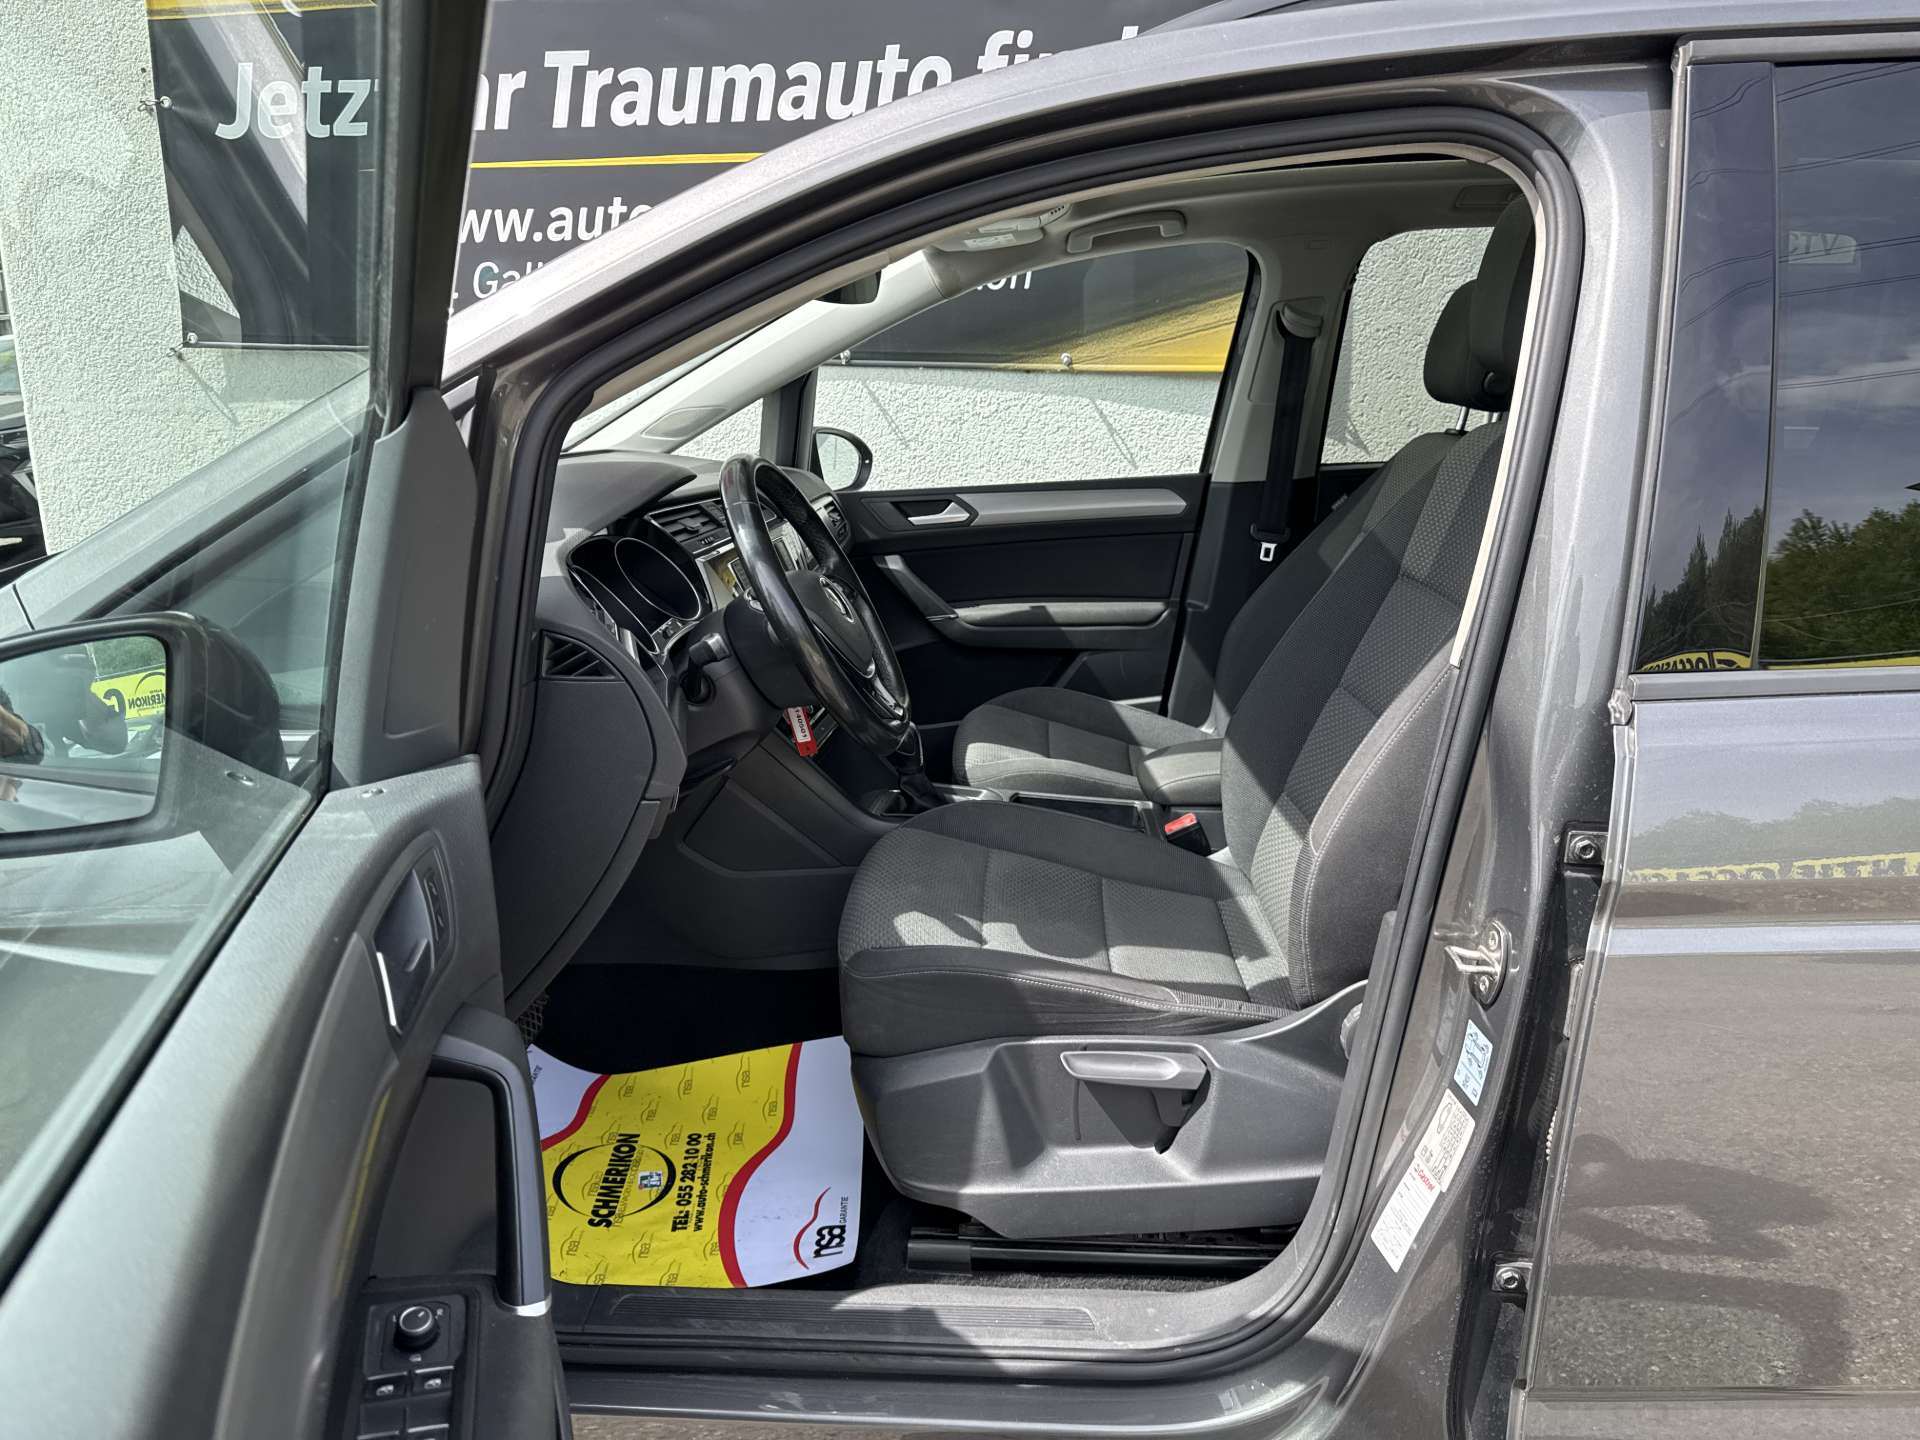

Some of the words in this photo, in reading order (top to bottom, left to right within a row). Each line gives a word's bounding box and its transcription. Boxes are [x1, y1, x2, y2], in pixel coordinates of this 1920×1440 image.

[214, 62, 379, 140] Jetz
[687, 1133, 702, 1147] 00
[684, 1148, 700, 1162] 10
[587, 1133, 641, 1229] SCHMERIKON
[680, 1162, 698, 1184] 282
[693, 1132, 717, 1233] www.auto-schmerikon.ch
[676, 1184, 694, 1207] 055
[671, 1209, 690, 1232] TEL:
[812, 1224, 847, 1259] nsa
